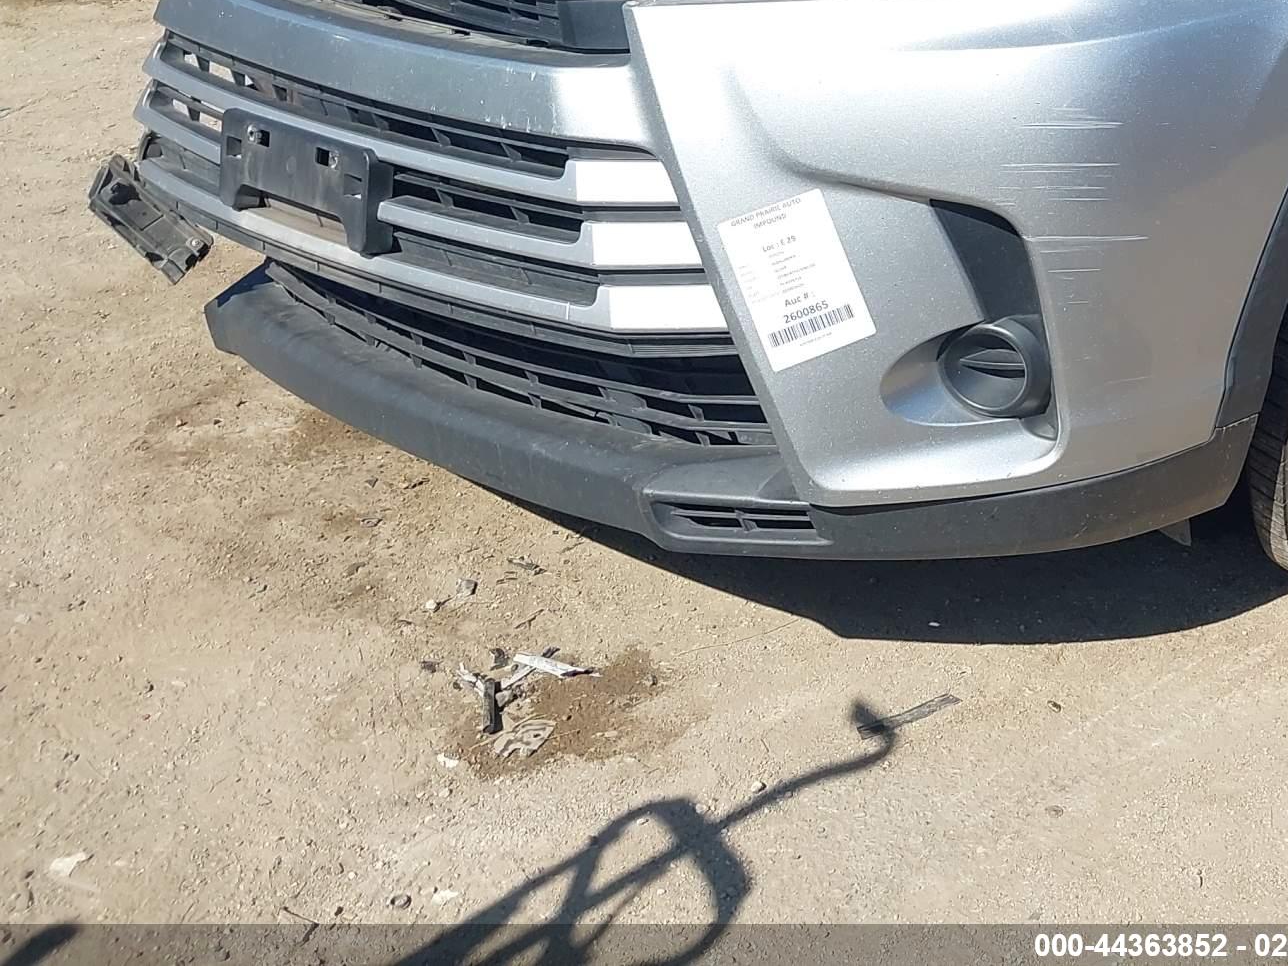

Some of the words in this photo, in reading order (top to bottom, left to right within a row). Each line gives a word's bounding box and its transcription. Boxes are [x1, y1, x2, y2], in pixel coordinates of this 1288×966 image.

[730, 214, 755, 227] GRAND
[755, 204, 782, 219] PRAIRIE
[782, 197, 802, 209] AUTO
[753, 212, 787, 230] IMPOUND
[784, 295, 801, 307] Auc
[783, 300, 829, 324] 2600865
